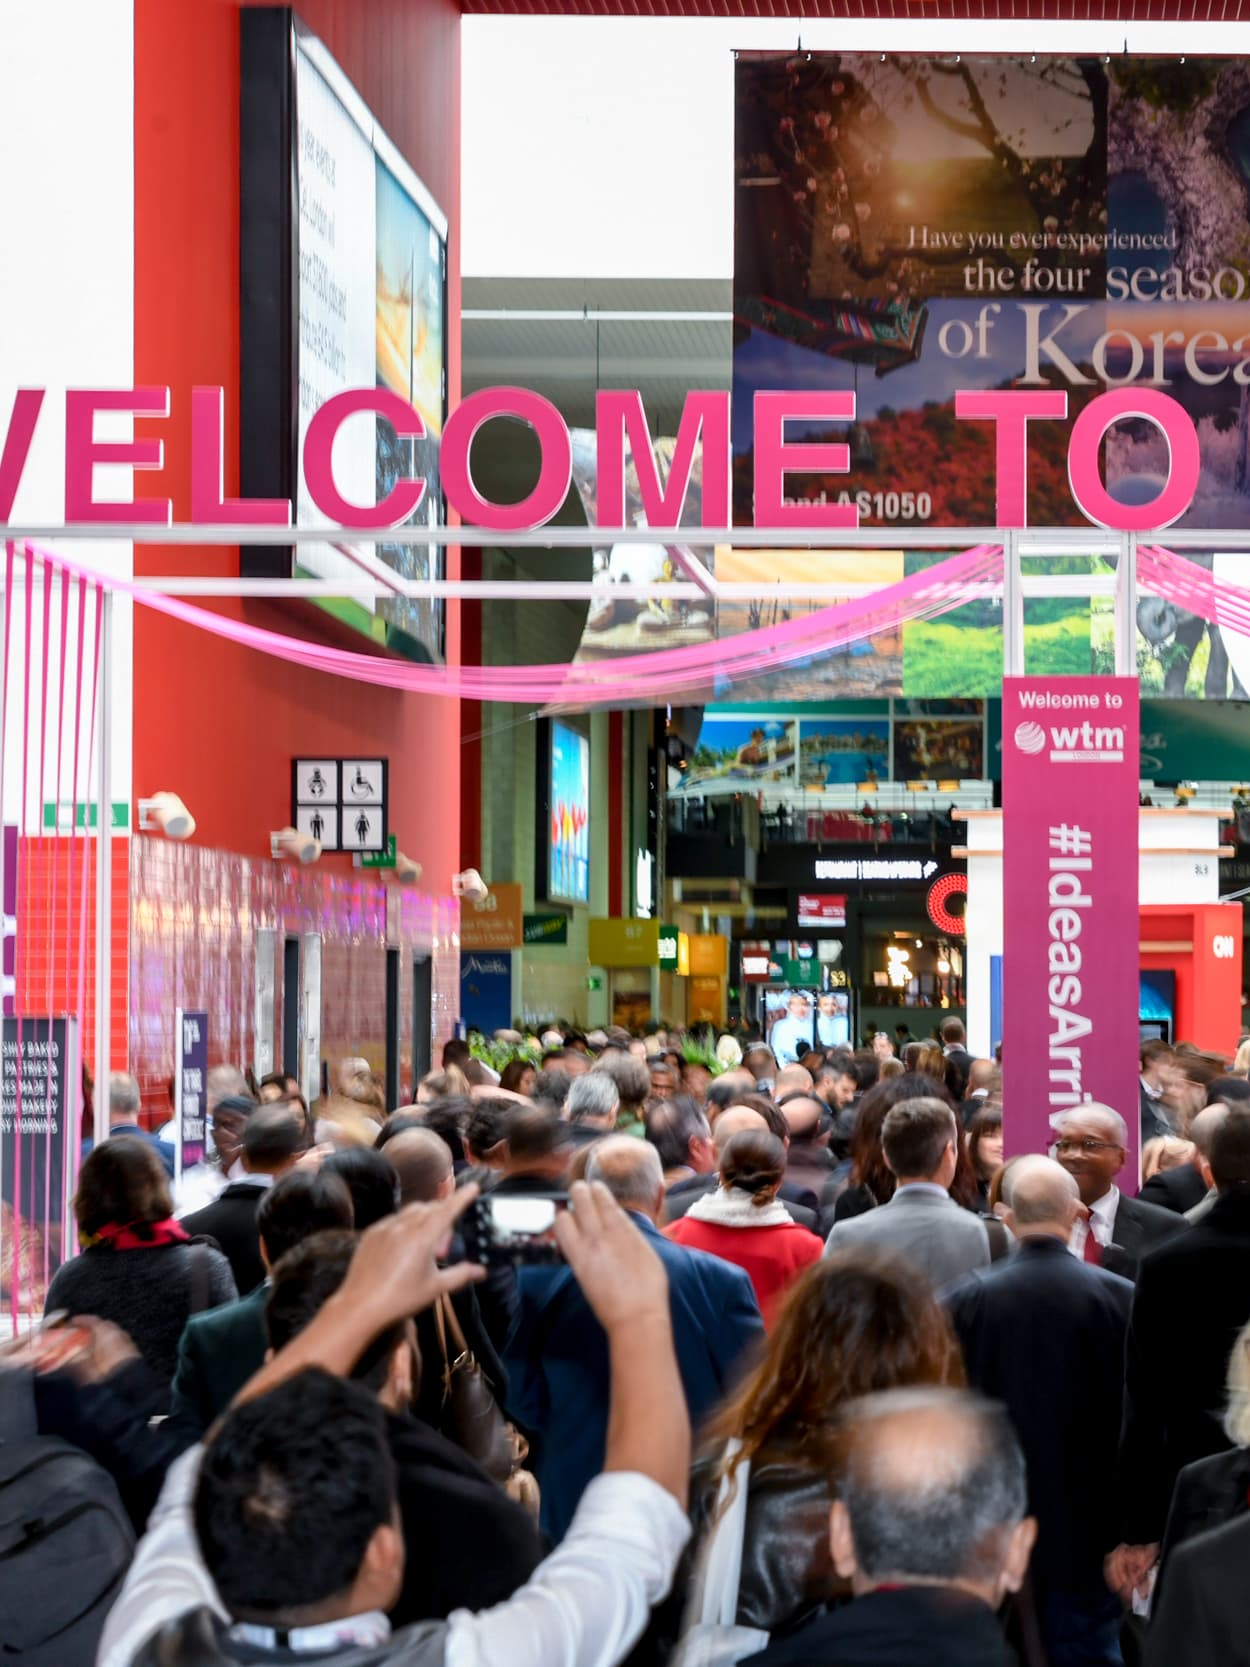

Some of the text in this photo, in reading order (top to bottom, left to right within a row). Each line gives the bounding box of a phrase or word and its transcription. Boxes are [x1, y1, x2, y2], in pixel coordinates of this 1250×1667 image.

[906, 225, 1178, 256] Have you ever experienced
[963, 258, 1015, 293] the
[1021, 258, 1091, 293] four
[937, 303, 1001, 360] of
[955, 385, 1201, 532] TO
[1018, 690, 1123, 710] Welcome to
[1050, 721, 1124, 750] wtm
[4, 1059, 47, 1077] PATRIES
